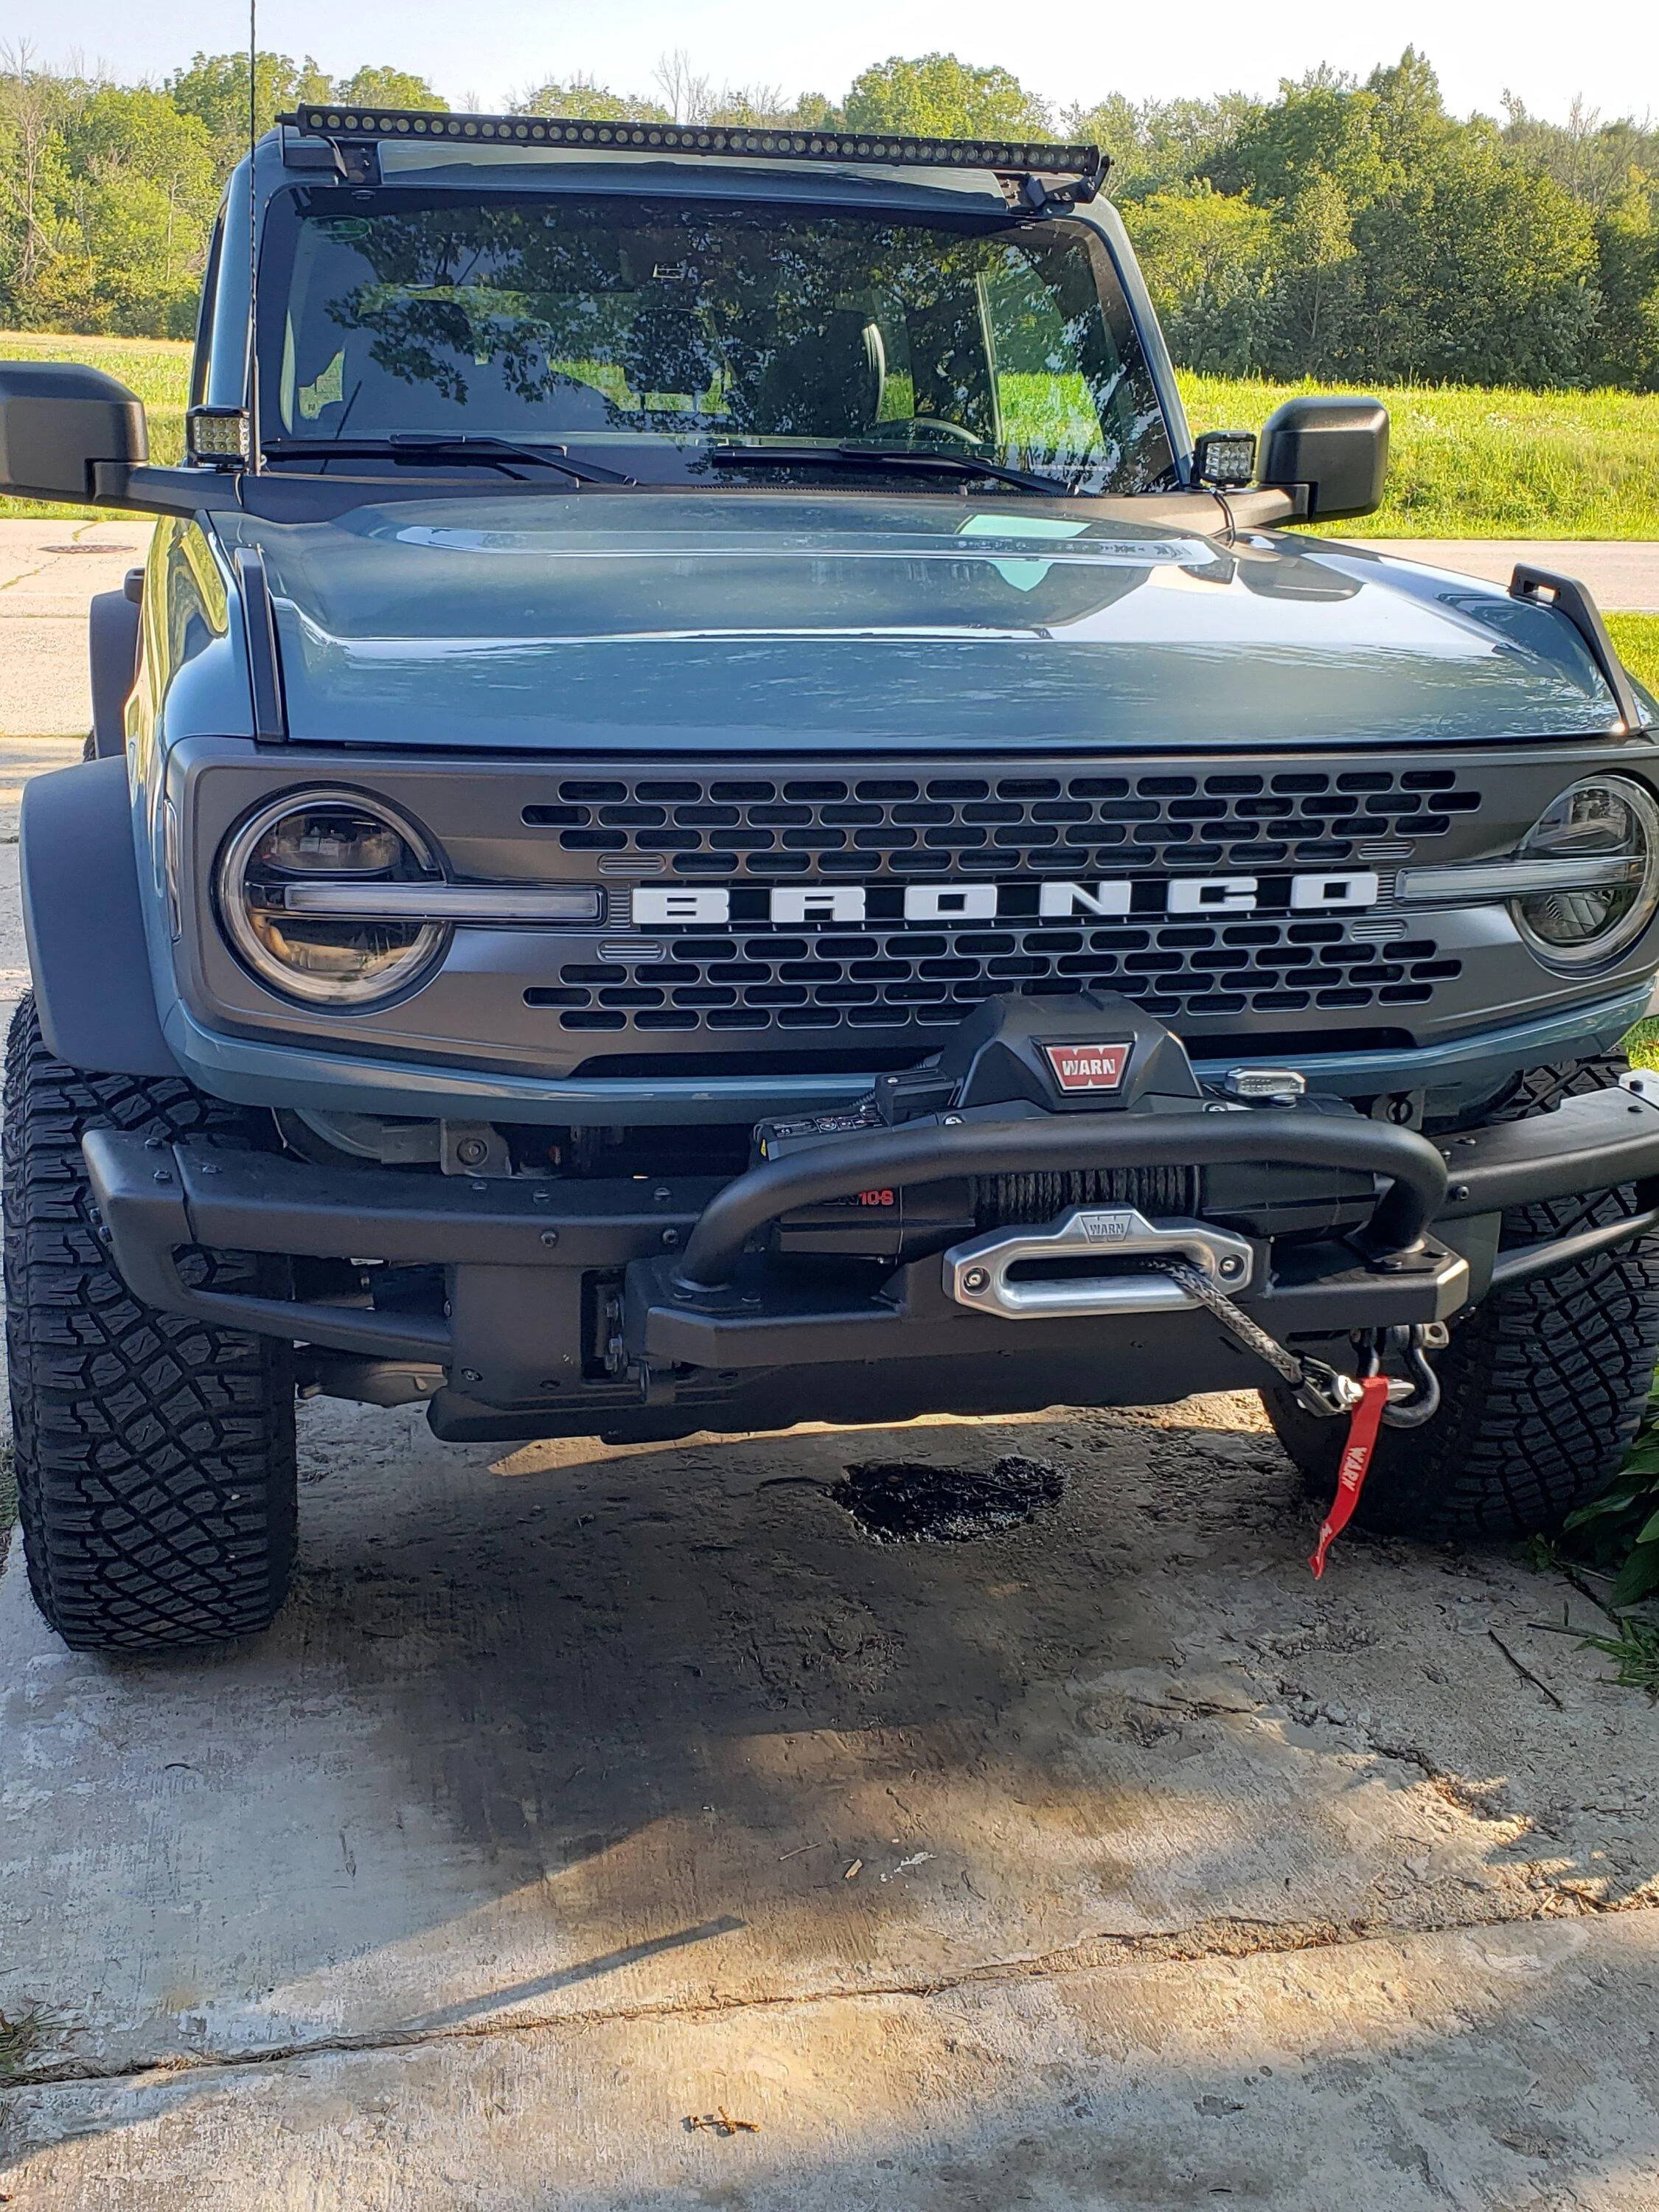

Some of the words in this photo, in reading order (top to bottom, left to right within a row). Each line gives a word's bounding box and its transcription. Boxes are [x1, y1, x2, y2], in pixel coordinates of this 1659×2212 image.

[631, 872, 1378, 924] BRONCO
[1062, 1059, 1116, 1076] WARN
[1090, 1222, 1124, 1235] WARN
[1341, 1447, 1368, 1492] WARN
